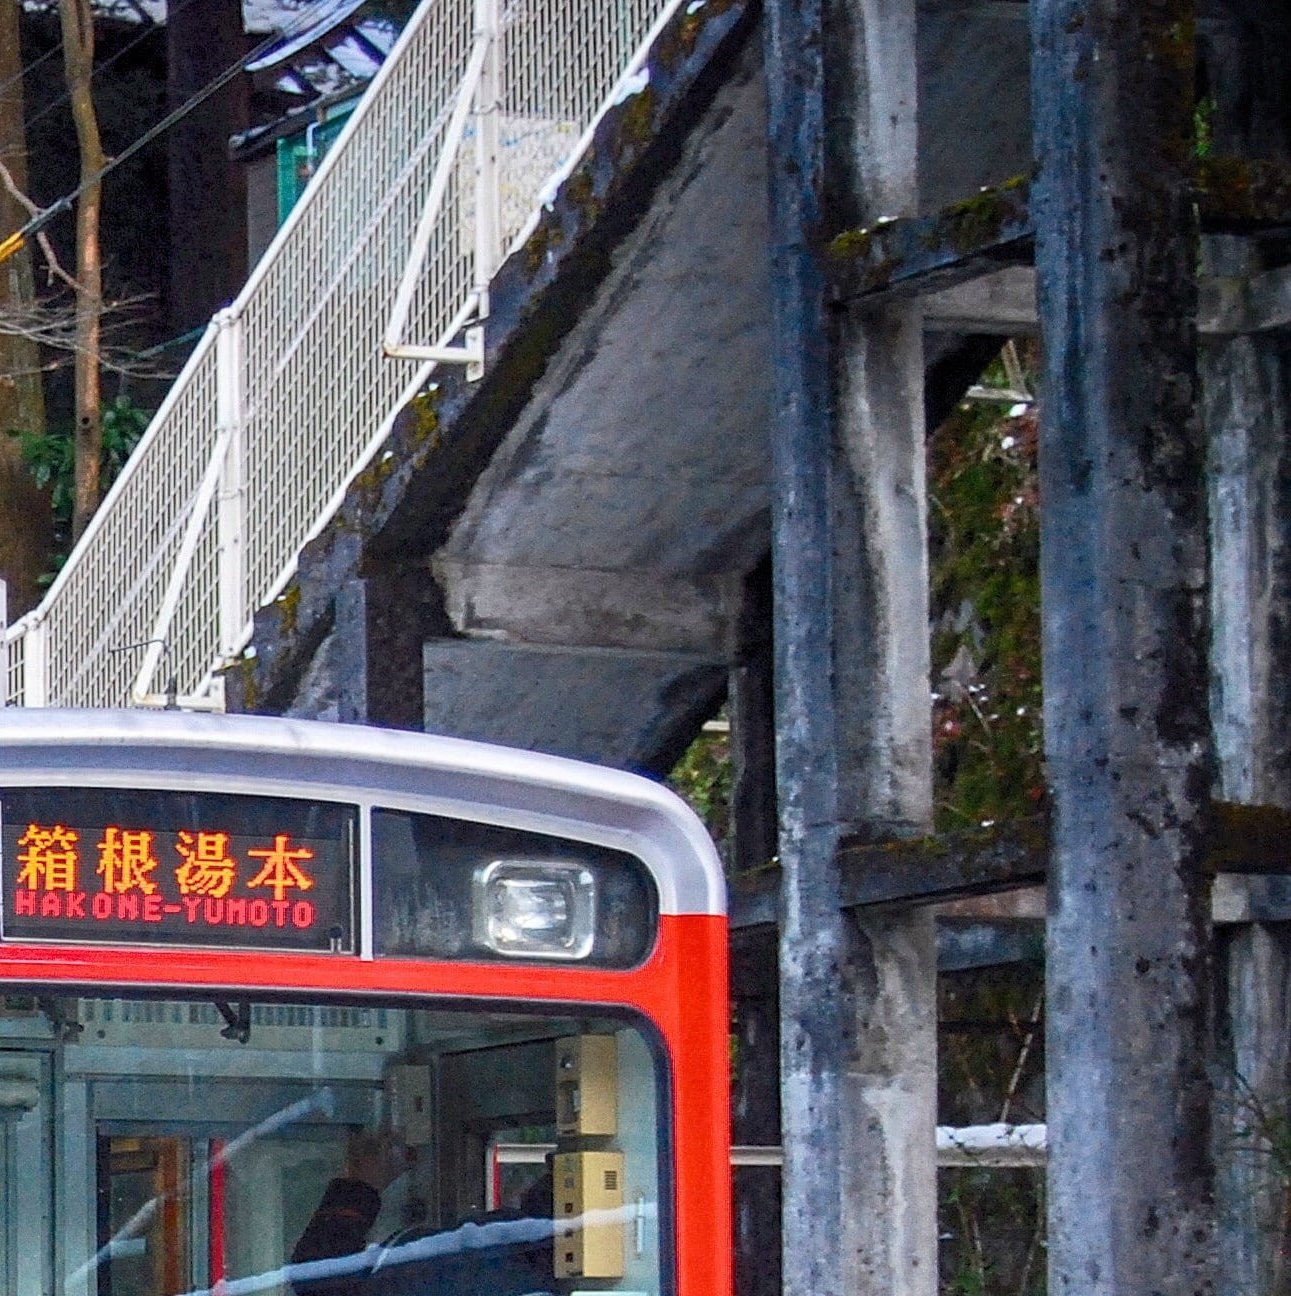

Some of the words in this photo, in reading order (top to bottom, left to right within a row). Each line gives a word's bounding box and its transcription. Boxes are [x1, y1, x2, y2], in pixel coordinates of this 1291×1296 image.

[16, 823, 315, 900] 箱根湯本
[14, 889, 316, 929] HAKONE-YUMOTO
